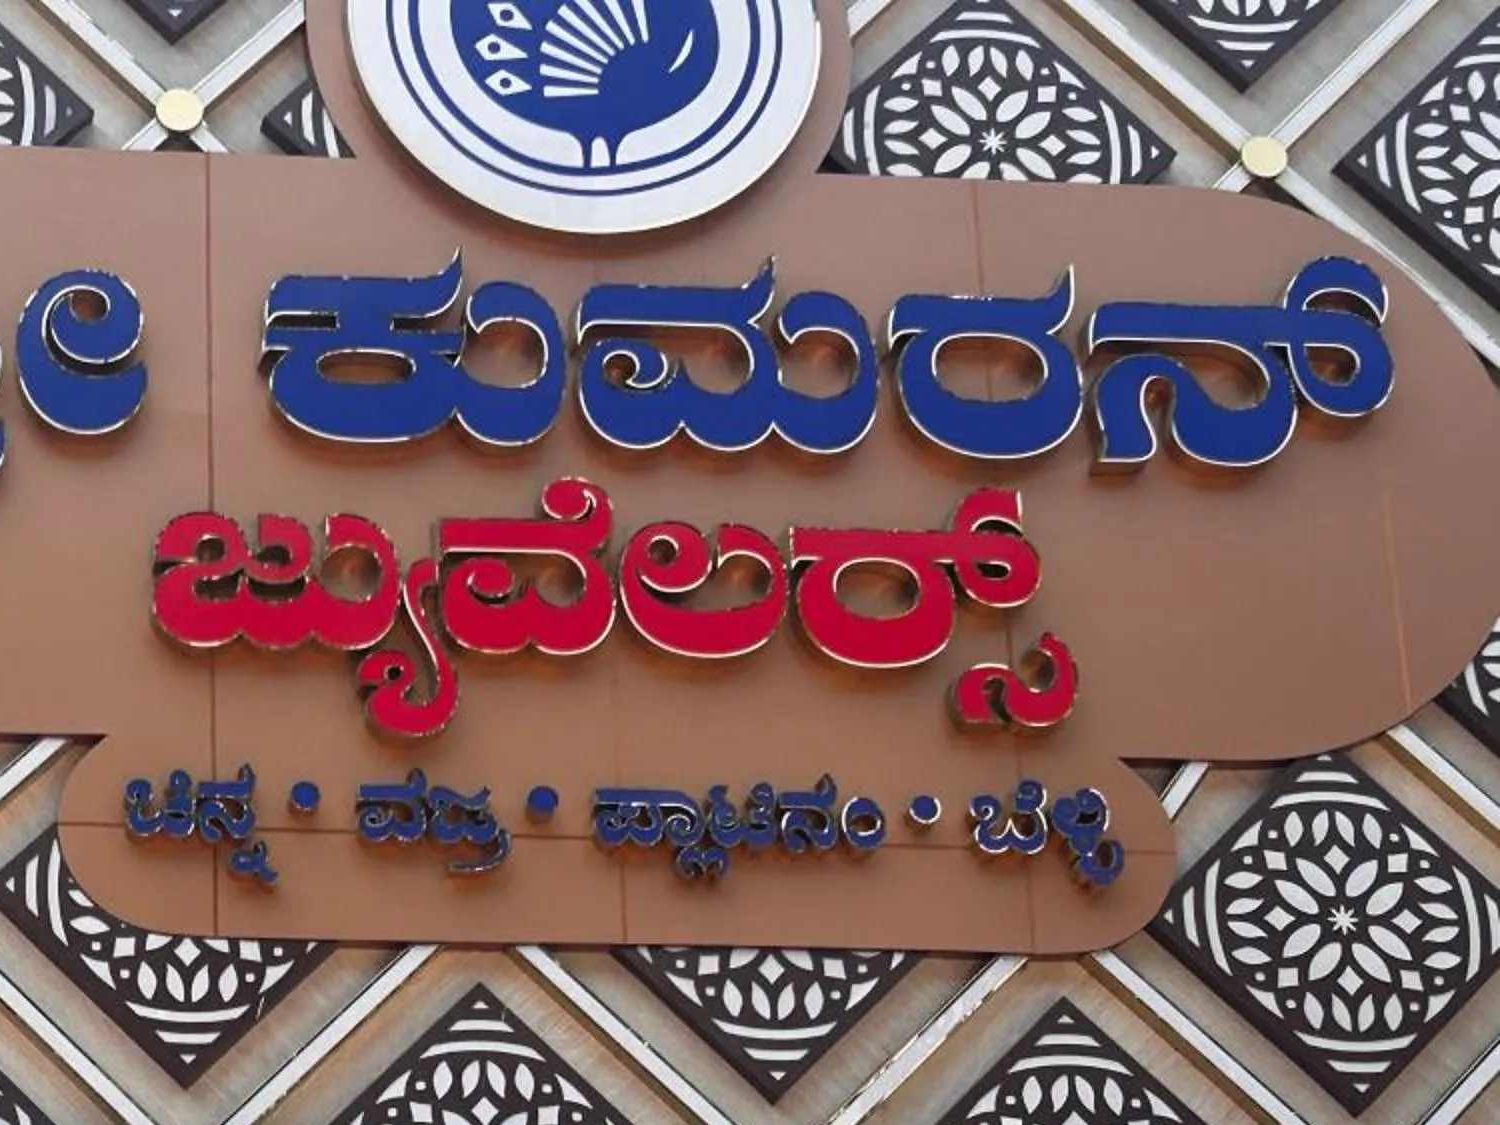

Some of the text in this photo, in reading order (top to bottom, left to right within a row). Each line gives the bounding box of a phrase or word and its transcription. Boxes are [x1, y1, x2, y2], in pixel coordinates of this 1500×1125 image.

[260, 246, 1395, 474] ಕುಮರನ್
[153, 477, 1079, 743] ಜ್ಯುವೆಲರ್ಸ್
[124, 763, 1125, 888] ಚಿನ್ನ ವಜ್ರ ಪ್ಲಾಟಿನಂ ಬೆಳ್ಳಿ
